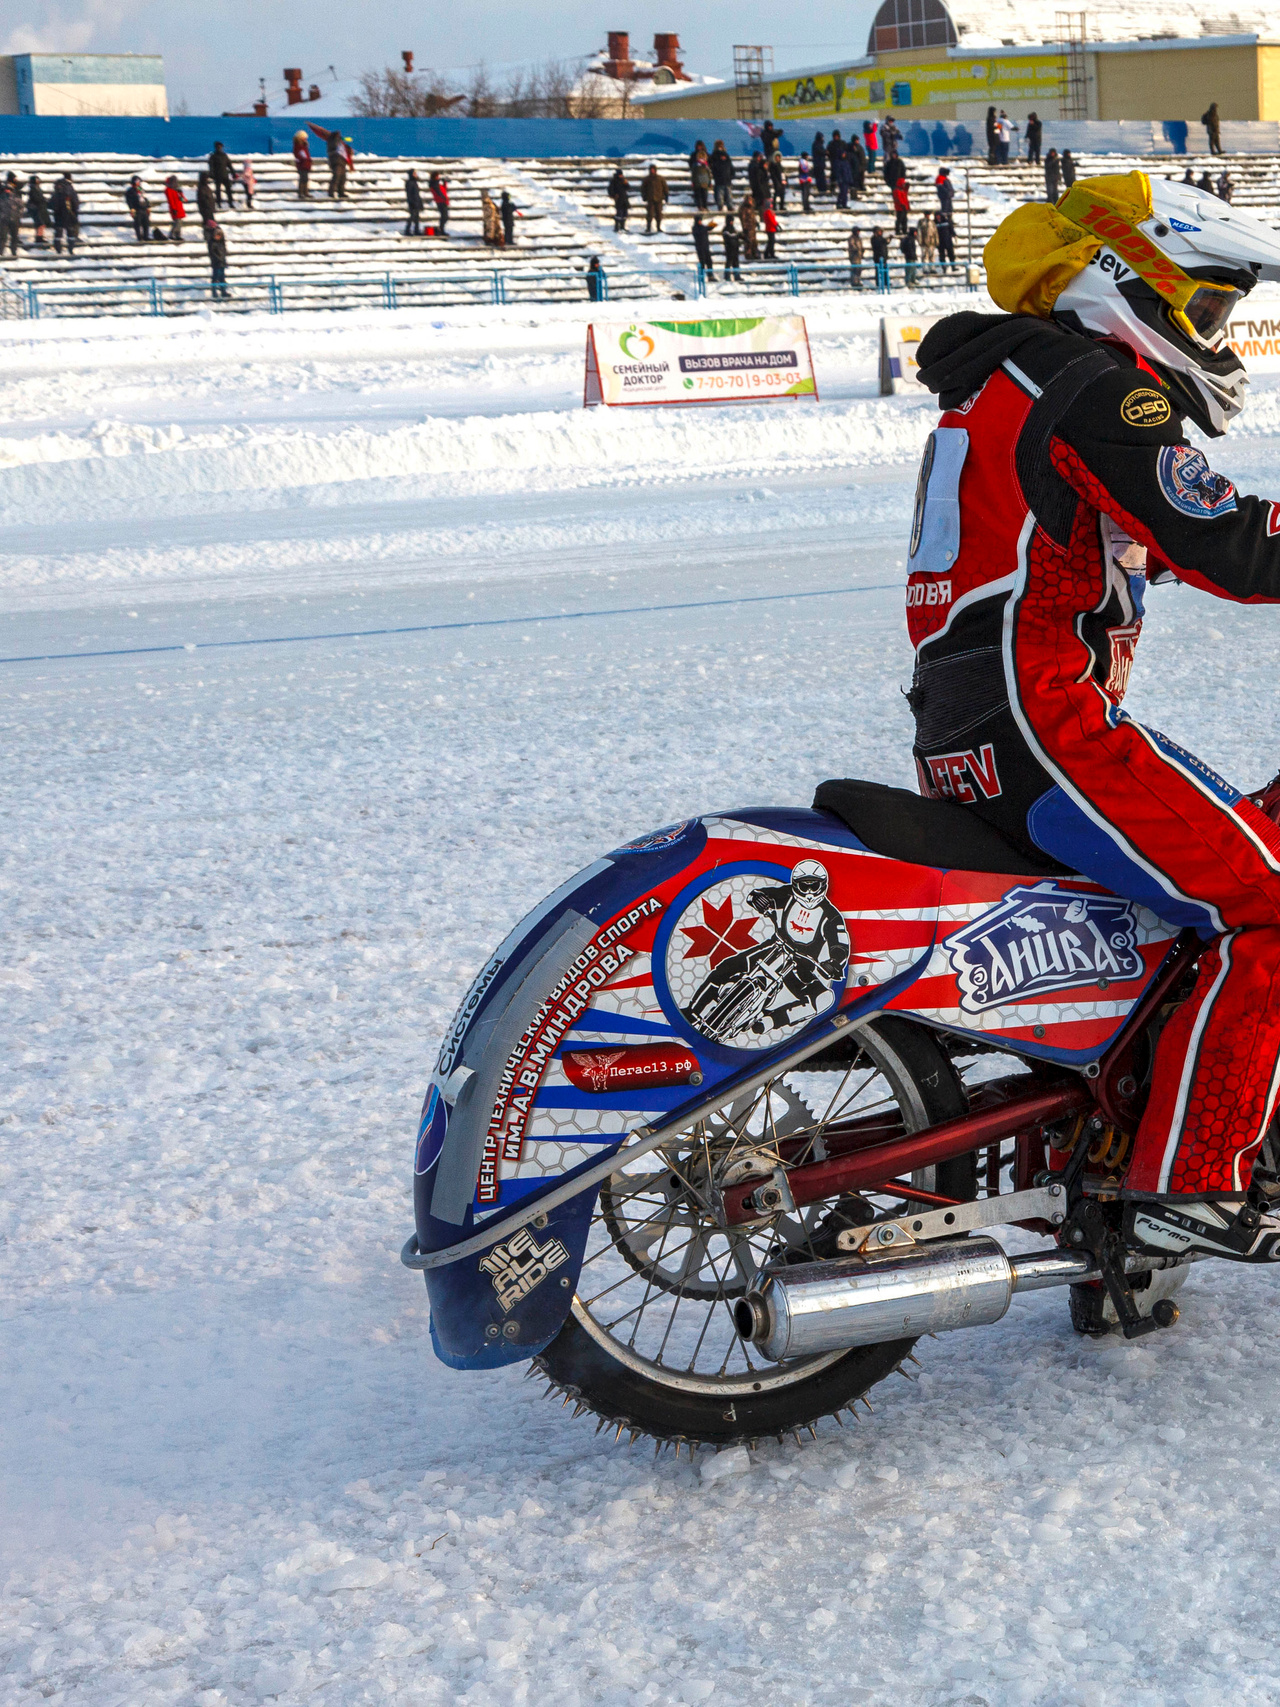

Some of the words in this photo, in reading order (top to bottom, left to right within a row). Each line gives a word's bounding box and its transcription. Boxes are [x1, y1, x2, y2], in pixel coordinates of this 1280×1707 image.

[1079, 203, 1189, 294] 100%
[612, 361, 670, 375] СЕМЕЙНЫЙ
[684, 358, 720, 369] ВЫЗОВ
[722, 356, 754, 368] ВРАЧА
[755, 356, 769, 366] НА
[769, 354, 792, 366] ДОМ
[623, 374, 663, 386] ДОКТОР
[696, 375, 744, 389] 7-70-70
[752, 372, 802, 386] 9-03-03
[1125, 399, 1168, 421] DSO
[479, 1133, 497, 1201] ЦЕНТР
[597, 896, 664, 948] СПОРТА
[610, 1059, 692, 1077] Пегас13.рф
[494, 1241, 555, 1293] ALL
[498, 1244, 568, 1312] RIDE
